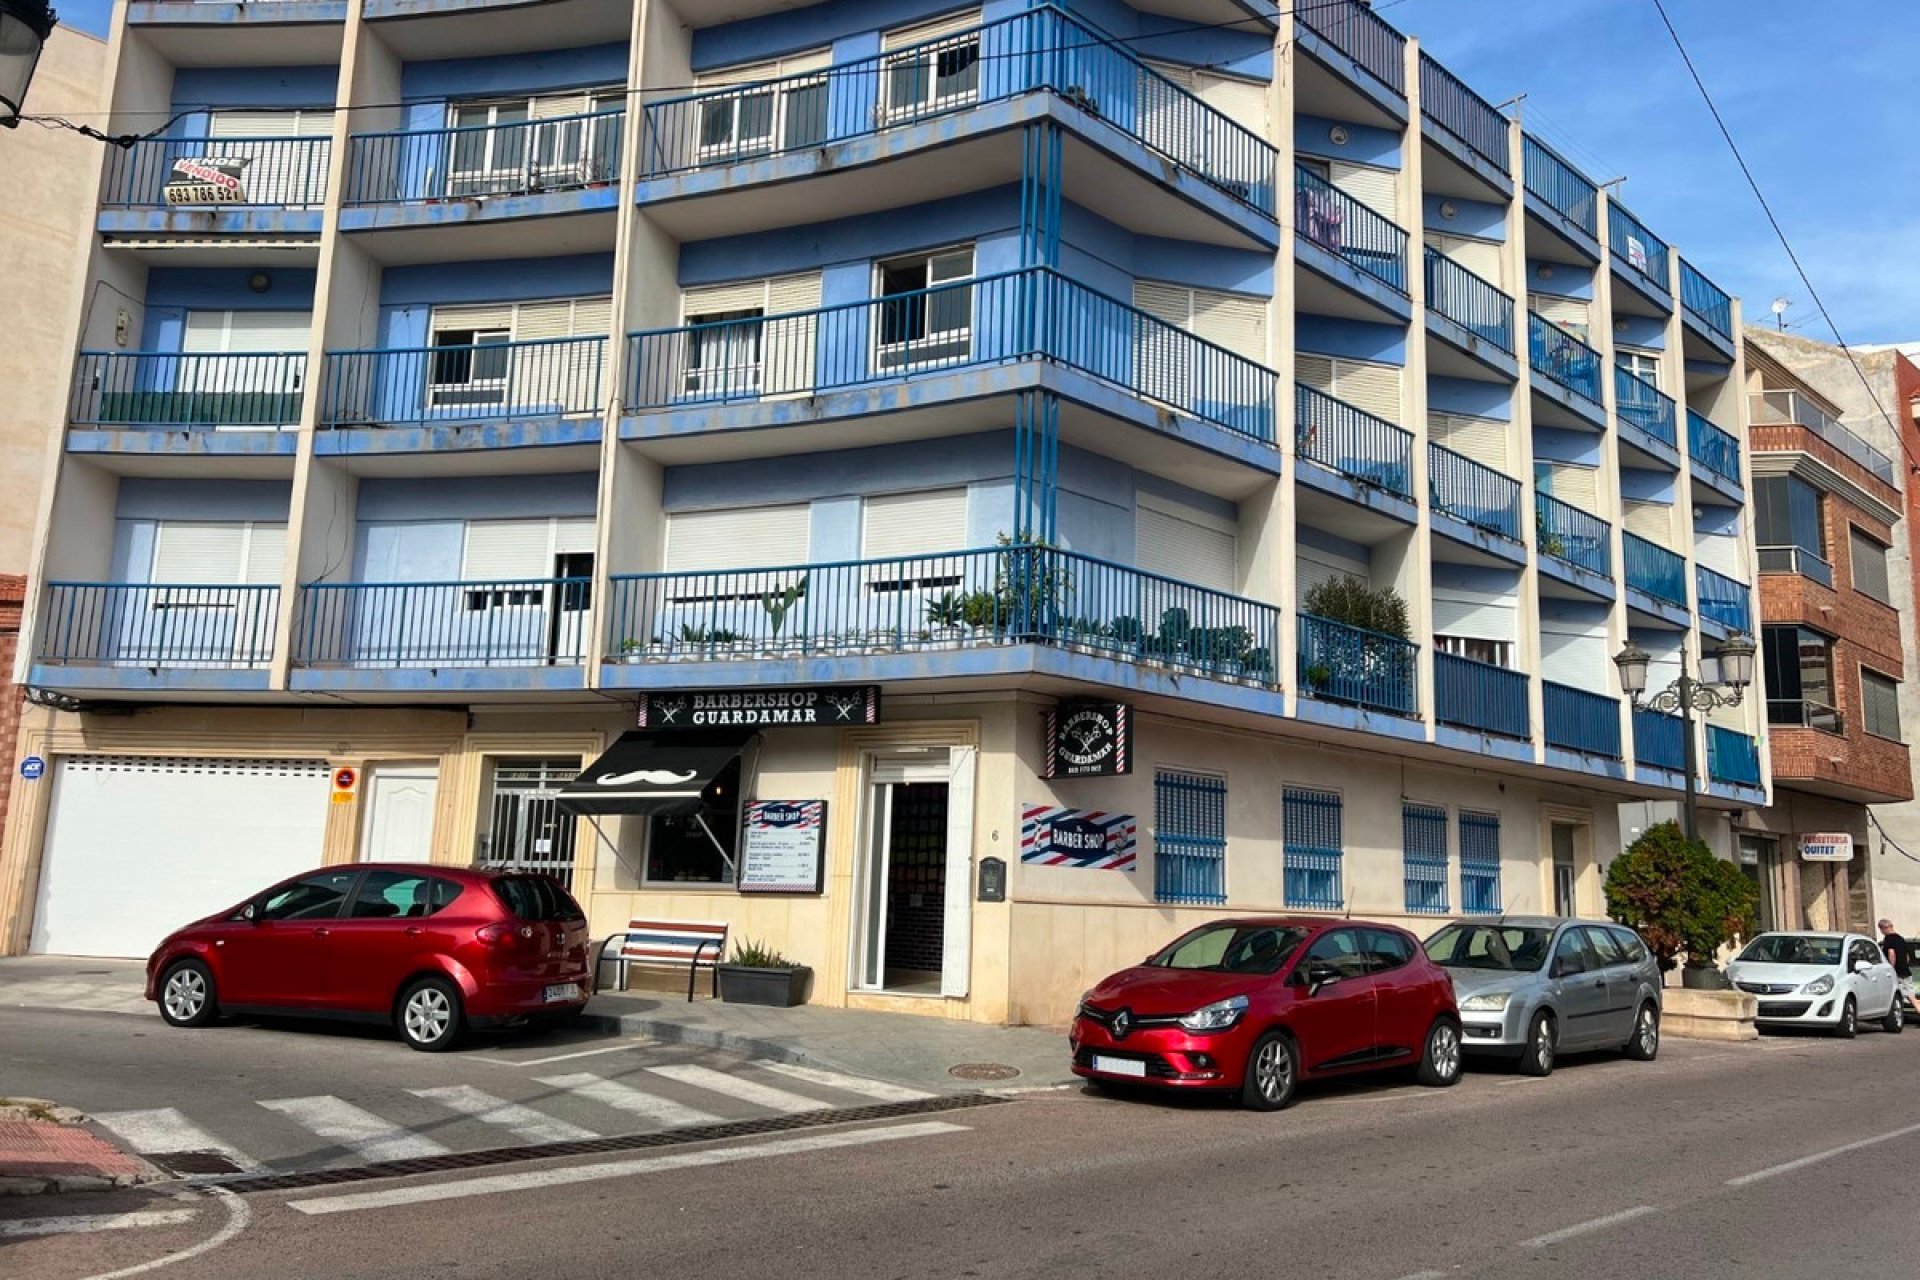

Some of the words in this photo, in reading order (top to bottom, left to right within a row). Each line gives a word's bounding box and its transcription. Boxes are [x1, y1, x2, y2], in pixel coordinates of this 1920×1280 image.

[178, 160, 238, 189] VENDIDO
[169, 187, 191, 203] 693
[693, 692, 818, 709] BARBERSHOP
[692, 708, 817, 725] GUARDAMAR
[1059, 742, 1113, 764] GUARDAMAR
[991, 829, 999, 842] 6
[1053, 828, 1083, 849] BARBER
[1084, 833, 1105, 849] SHOP
